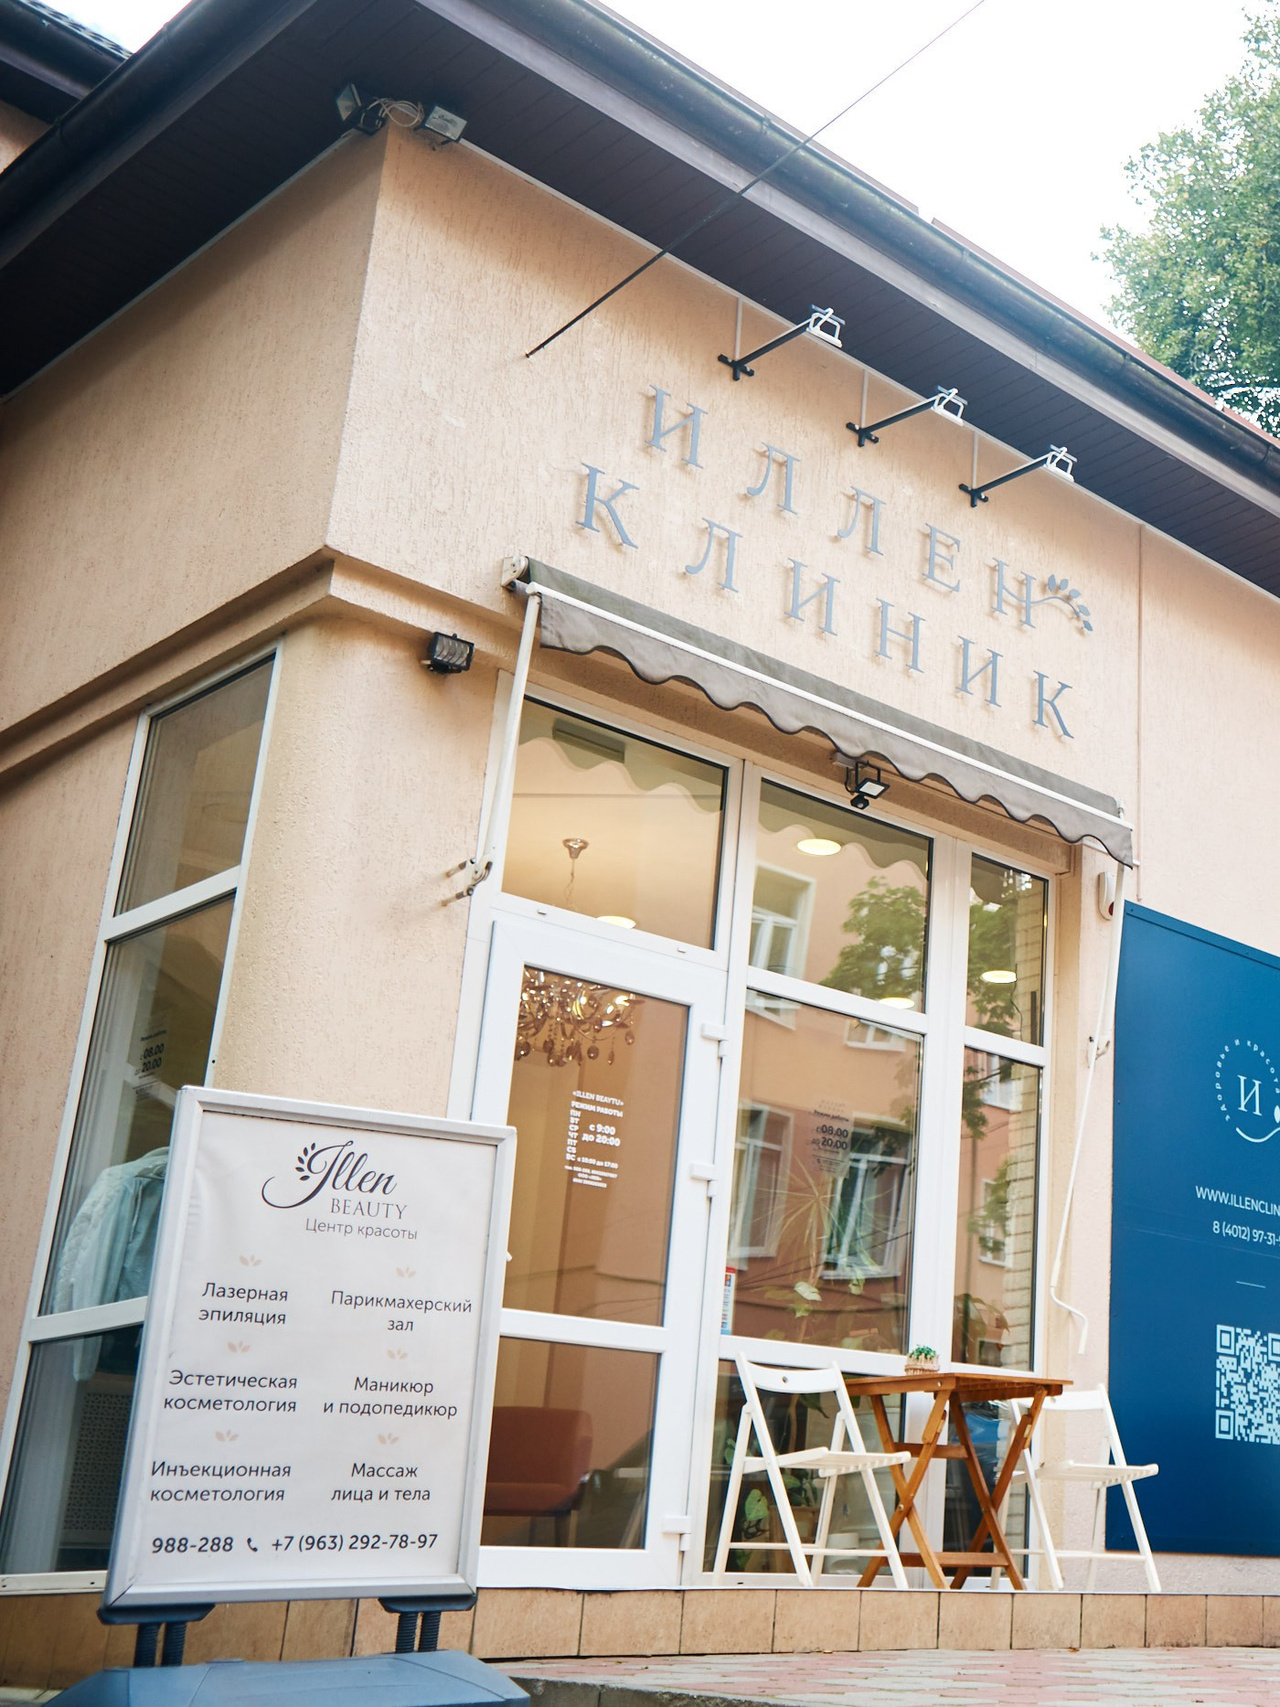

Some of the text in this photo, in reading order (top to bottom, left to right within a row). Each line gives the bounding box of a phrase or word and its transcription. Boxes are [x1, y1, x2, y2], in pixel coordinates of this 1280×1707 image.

[645, 384, 1037, 629] ИЛЛЕН
[575, 462, 1074, 739] КЛИНИК
[1237, 1074, 1263, 1117] И
[596, 1123, 616, 1136] 9:00
[821, 1124, 849, 1139] 08.00
[581, 1132, 621, 1147] до 20:00
[821, 1136, 848, 1150] 20.00
[331, 1198, 407, 1219] BEAUTY
[305, 1218, 418, 1240] Центр красоты
[1212, 1220, 1221, 1235] 8
[1222, 1221, 1251, 1242] (4012)
[202, 1282, 288, 1303] Лазерная
[331, 1290, 472, 1313] Парикмахерский
[199, 1309, 286, 1325] эпиляция
[387, 1319, 414, 1331] зал
[169, 1369, 297, 1389] Эстетическая
[354, 1376, 434, 1396] Маникюр
[164, 1398, 297, 1412] косметология
[323, 1402, 458, 1419] и подопедикюр
[151, 1461, 291, 1479] Инъекционная
[351, 1462, 418, 1478] Массаж
[150, 1489, 285, 1501] косметология
[331, 1489, 431, 1503] лица и тела
[152, 1536, 234, 1554] 988-288
[272, 1534, 438, 1552] +7 (963) 292-78-97
